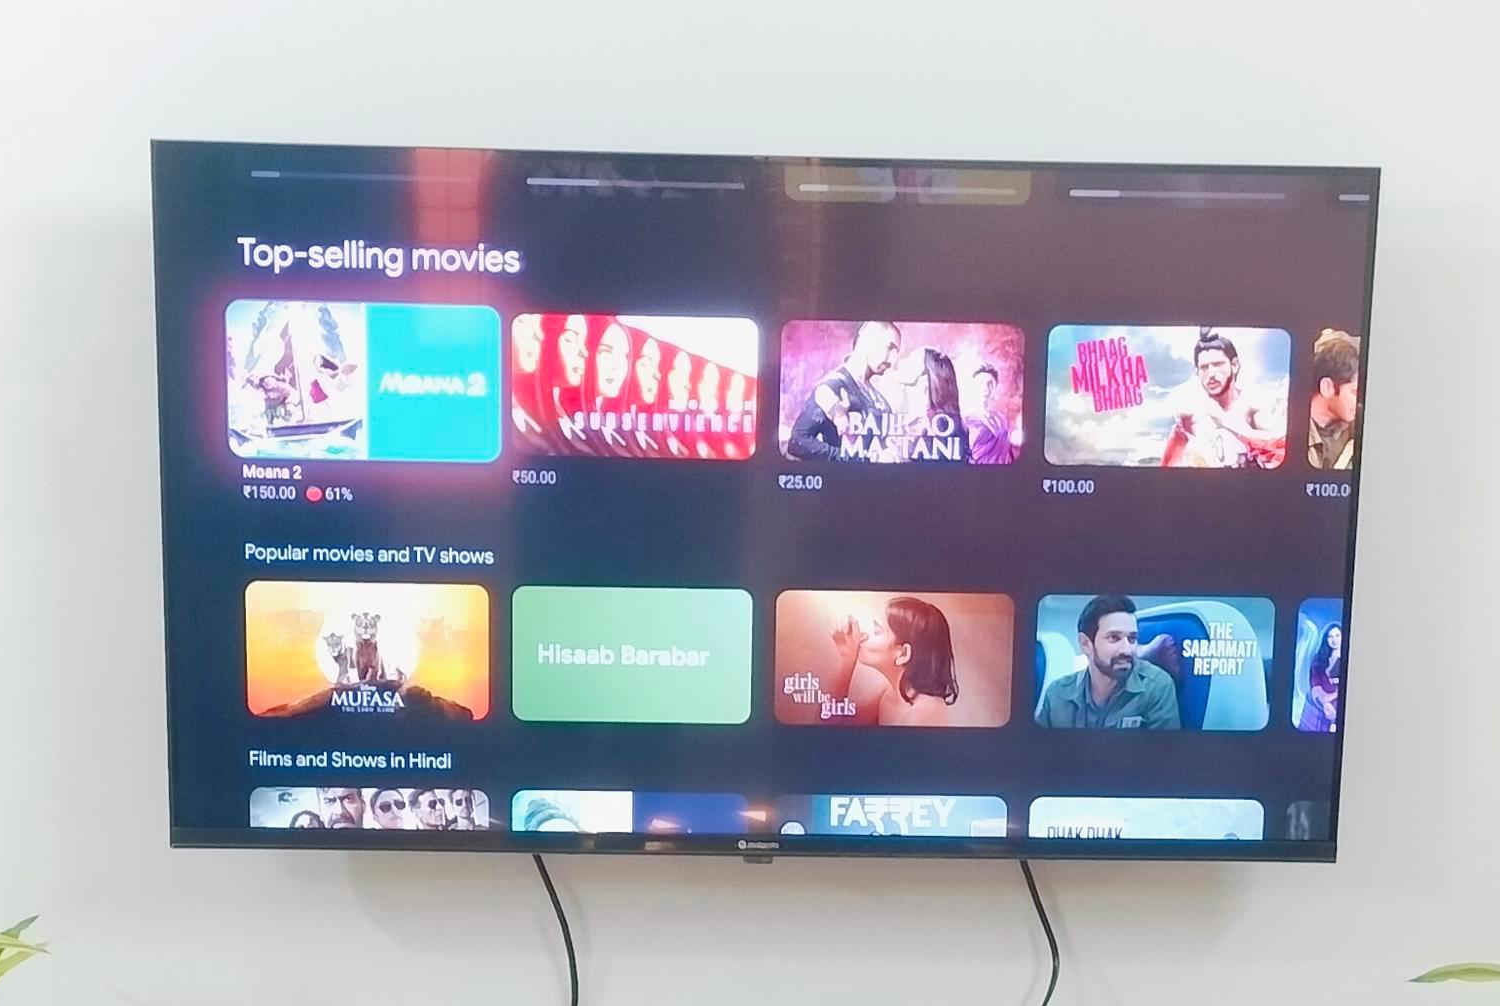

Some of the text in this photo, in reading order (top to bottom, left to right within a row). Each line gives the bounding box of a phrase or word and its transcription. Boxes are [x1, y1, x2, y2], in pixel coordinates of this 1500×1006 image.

[236, 236, 521, 278] Top-selling movies
[1076, 336, 1129, 365] BHAAG
[467, 371, 487, 397] 2
[1070, 354, 1149, 394] MILKHA
[1092, 384, 1144, 413] BHAAG
[847, 410, 955, 438] BAJIRAO
[839, 433, 962, 461] MASTANI
[242, 464, 302, 480] Moana 2
[512, 470, 557, 485] ₹50.00
[778, 474, 823, 490] ₹25.00
[242, 485, 353, 501] ₹150.00 61%
[1042, 479, 1095, 494] ₹100.00
[1305, 482, 1352, 498] ₹100.0
[244, 543, 495, 565] Popular movies and TV shows
[1208, 622, 1235, 640] THE
[536, 642, 711, 667] Hisaab Barabar
[1182, 639, 1258, 658] SABARMATI
[1193, 658, 1245, 676] REPORT
[783, 671, 820, 695] girls
[330, 689, 405, 708] MUFASA
[792, 688, 832, 704] will be
[820, 697, 857, 720] girls
[248, 749, 453, 770] Films and Shows in Hindi
